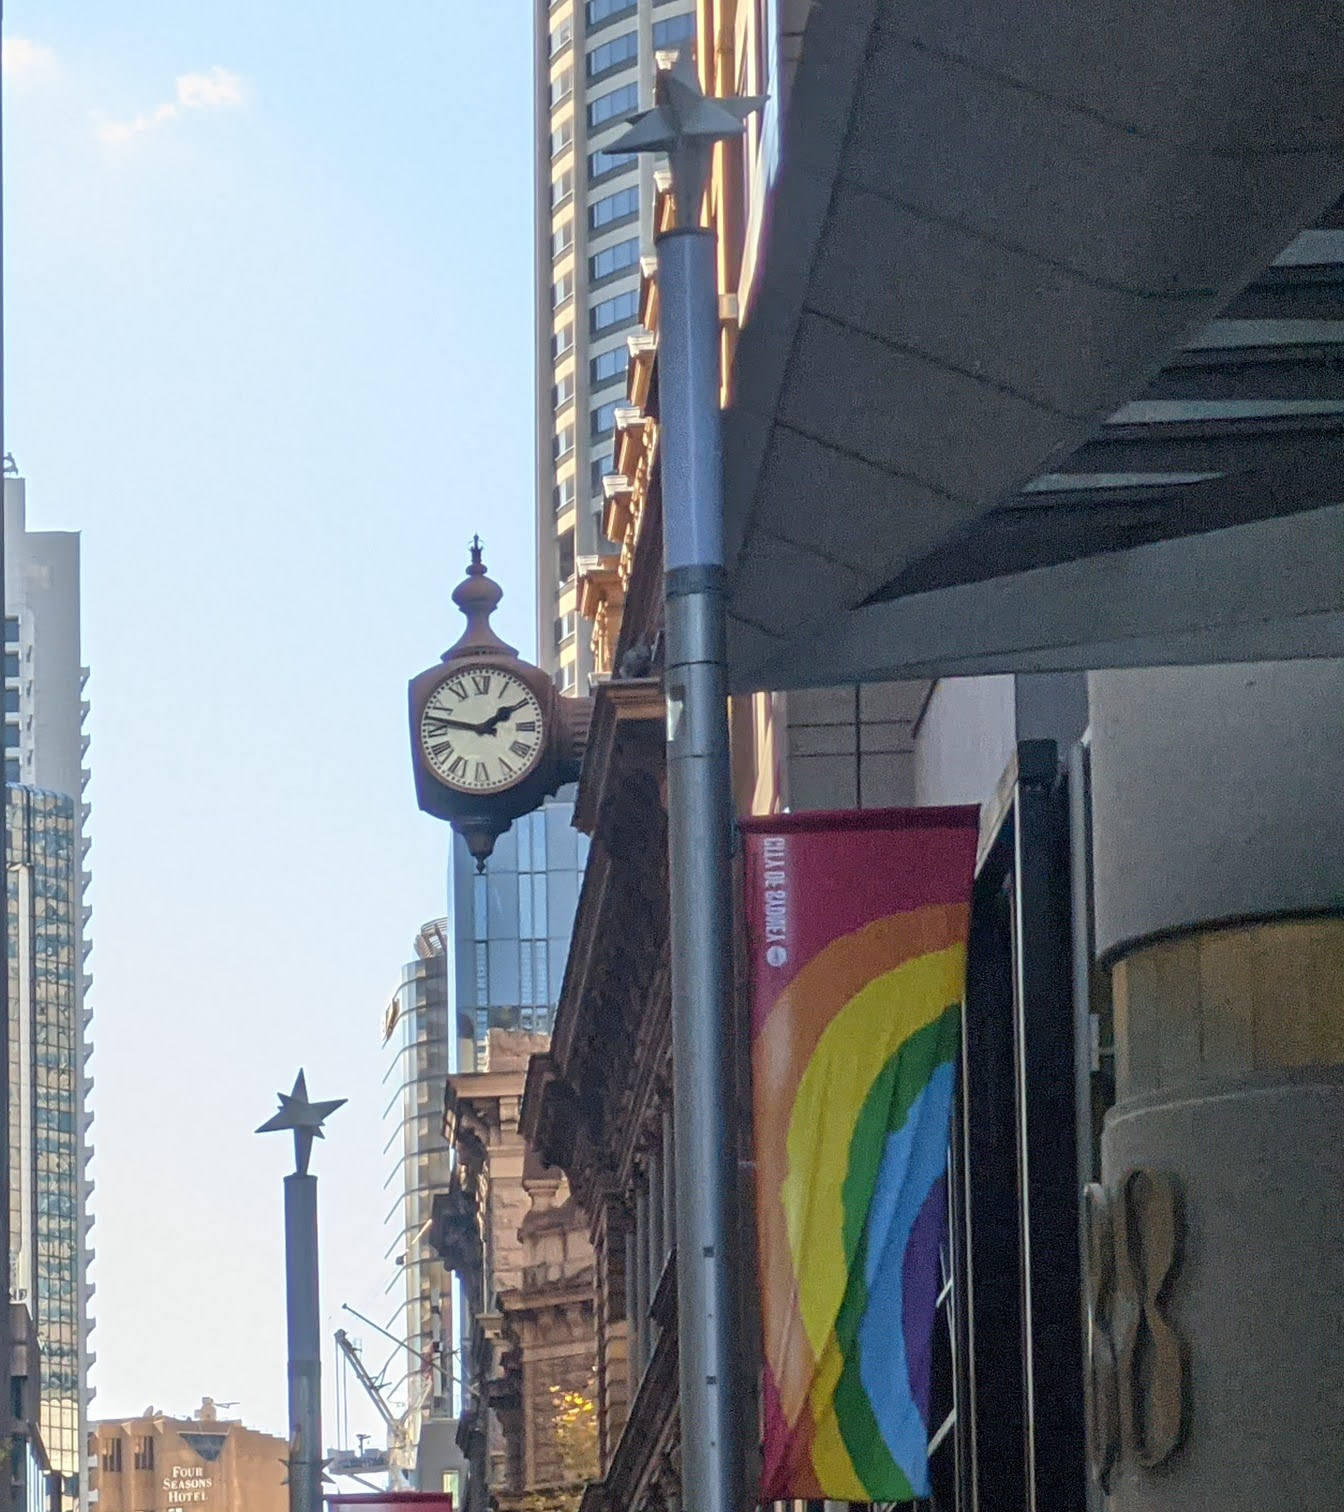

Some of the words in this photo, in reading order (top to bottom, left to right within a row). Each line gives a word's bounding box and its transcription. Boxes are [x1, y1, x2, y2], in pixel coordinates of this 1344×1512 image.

[172, 1465, 204, 1478] FOUR
[162, 1477, 214, 1492] SEASONS
[168, 1490, 209, 1503] HOTEL
